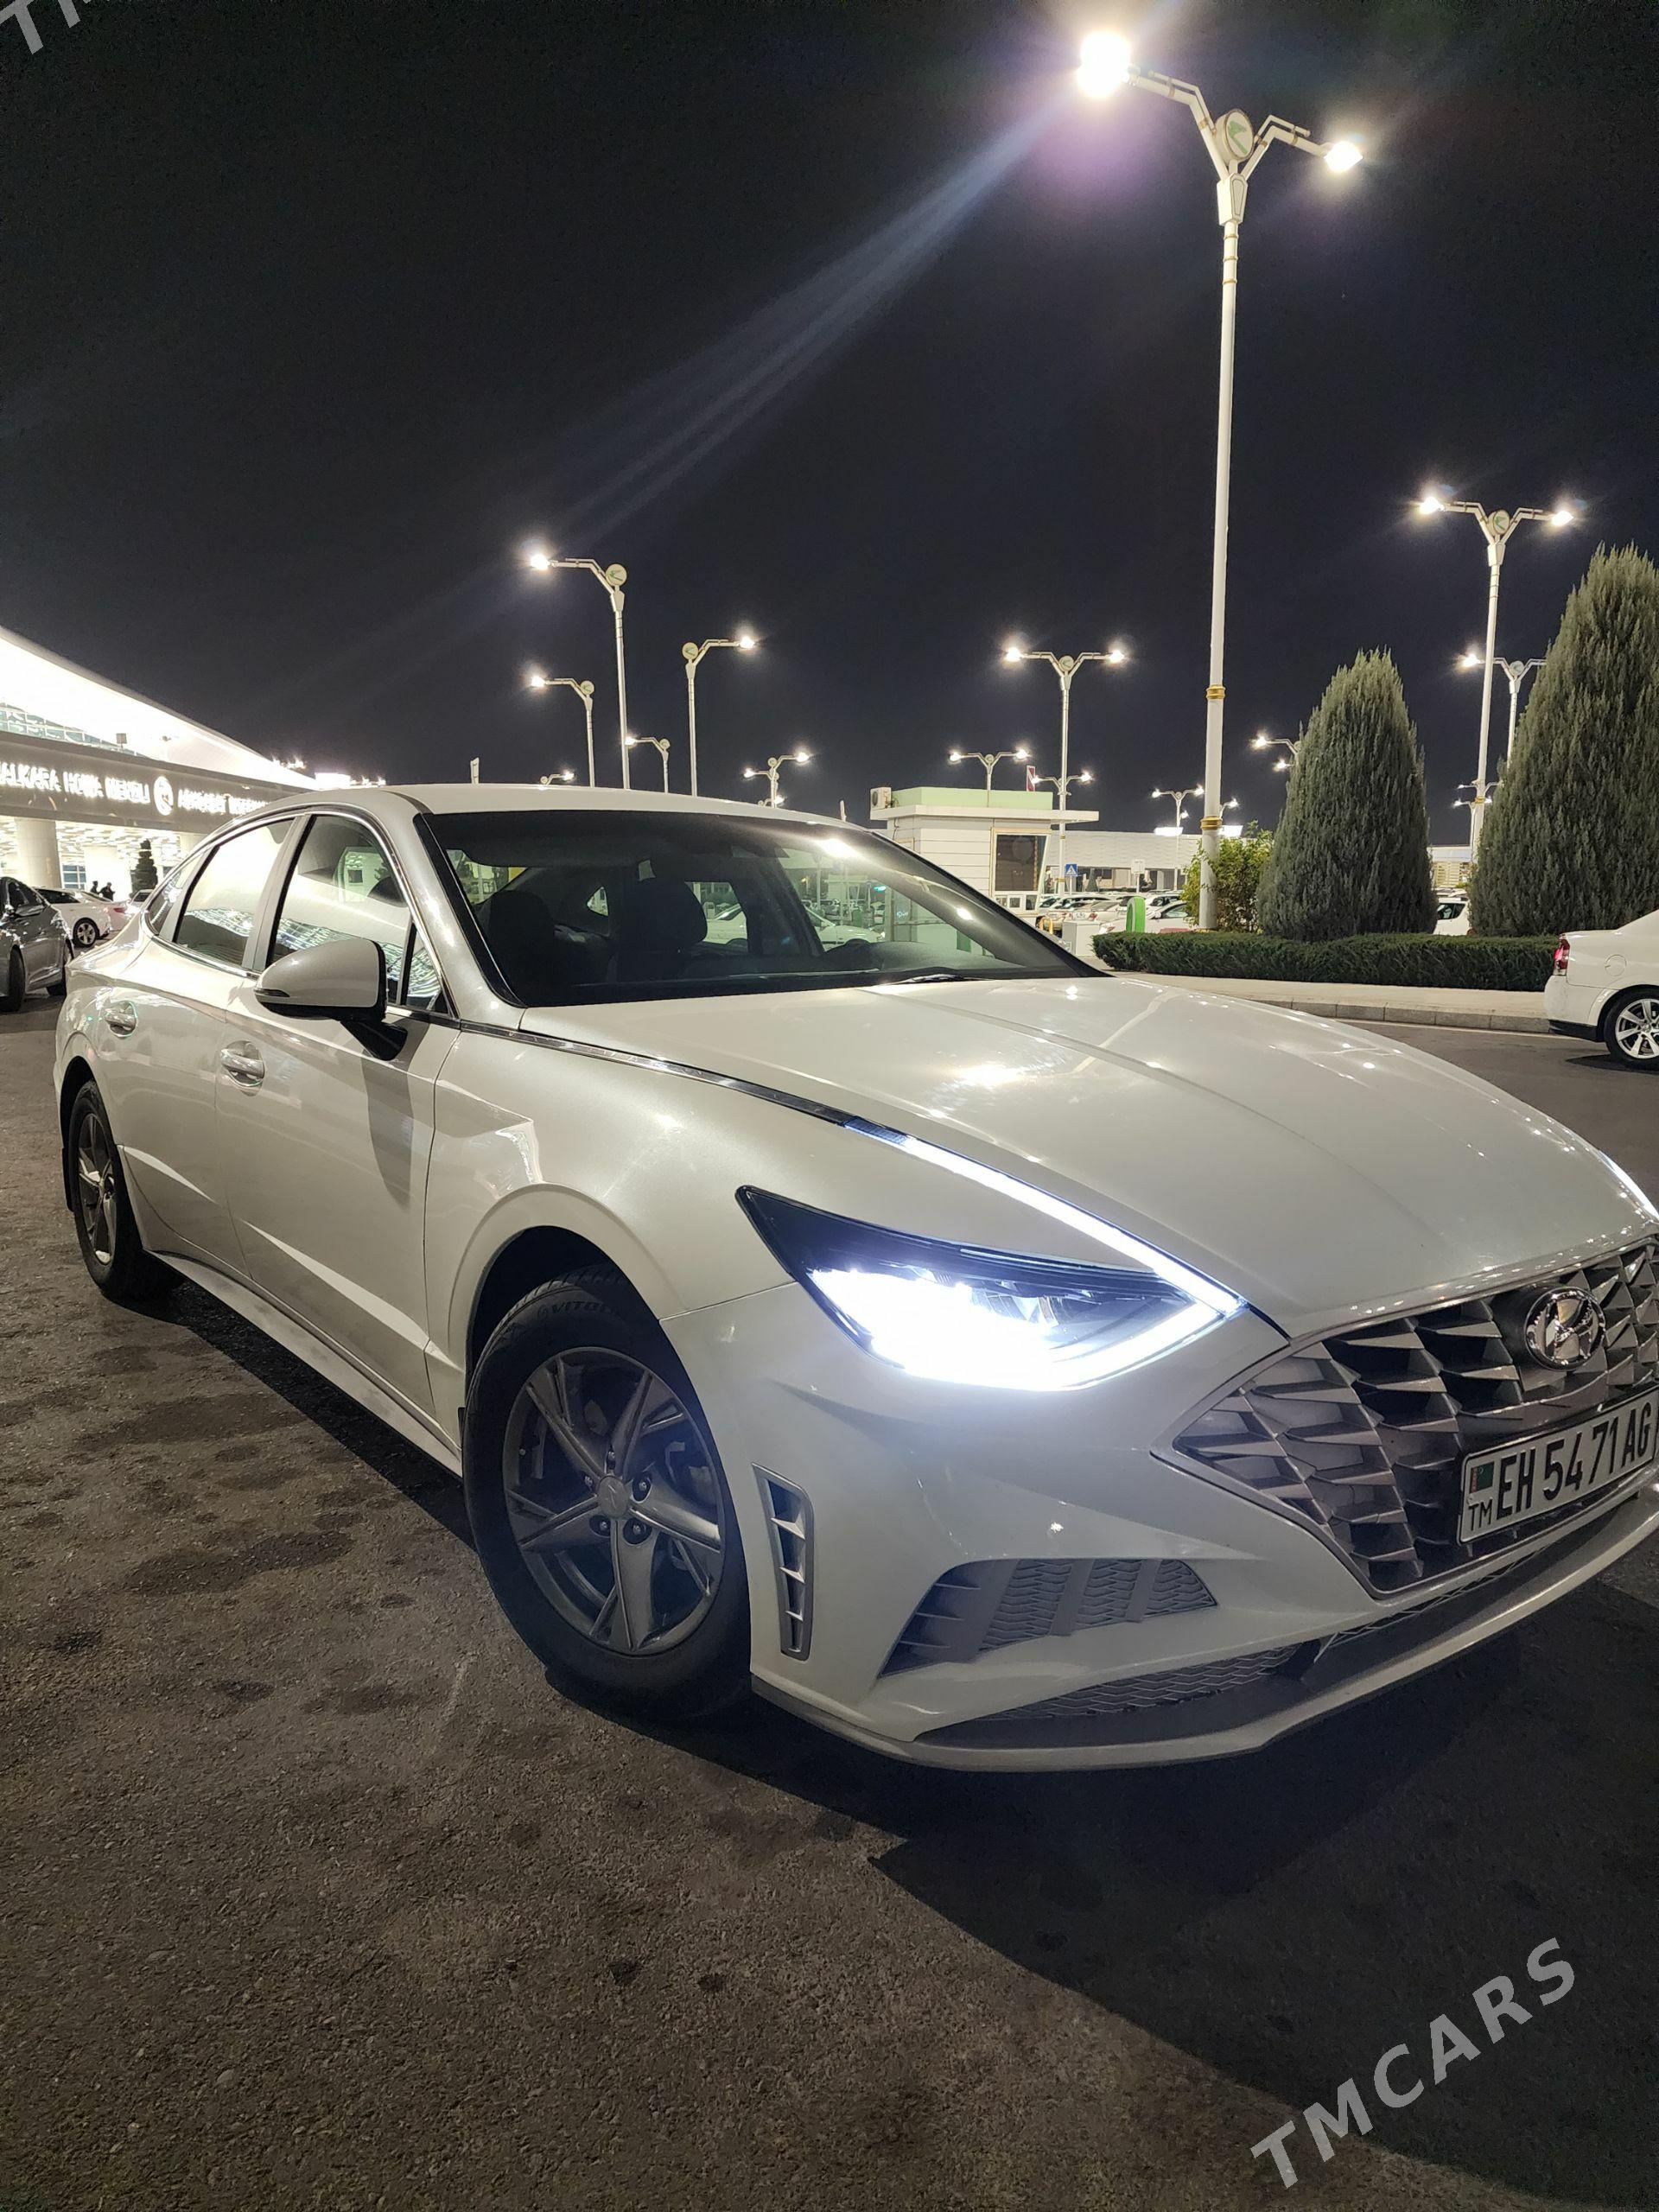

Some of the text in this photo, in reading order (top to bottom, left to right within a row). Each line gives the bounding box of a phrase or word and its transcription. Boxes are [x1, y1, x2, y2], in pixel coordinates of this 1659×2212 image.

[1497, 1402, 1652, 1520] EH 5471 AG
[1468, 1498, 1493, 1531] TM
